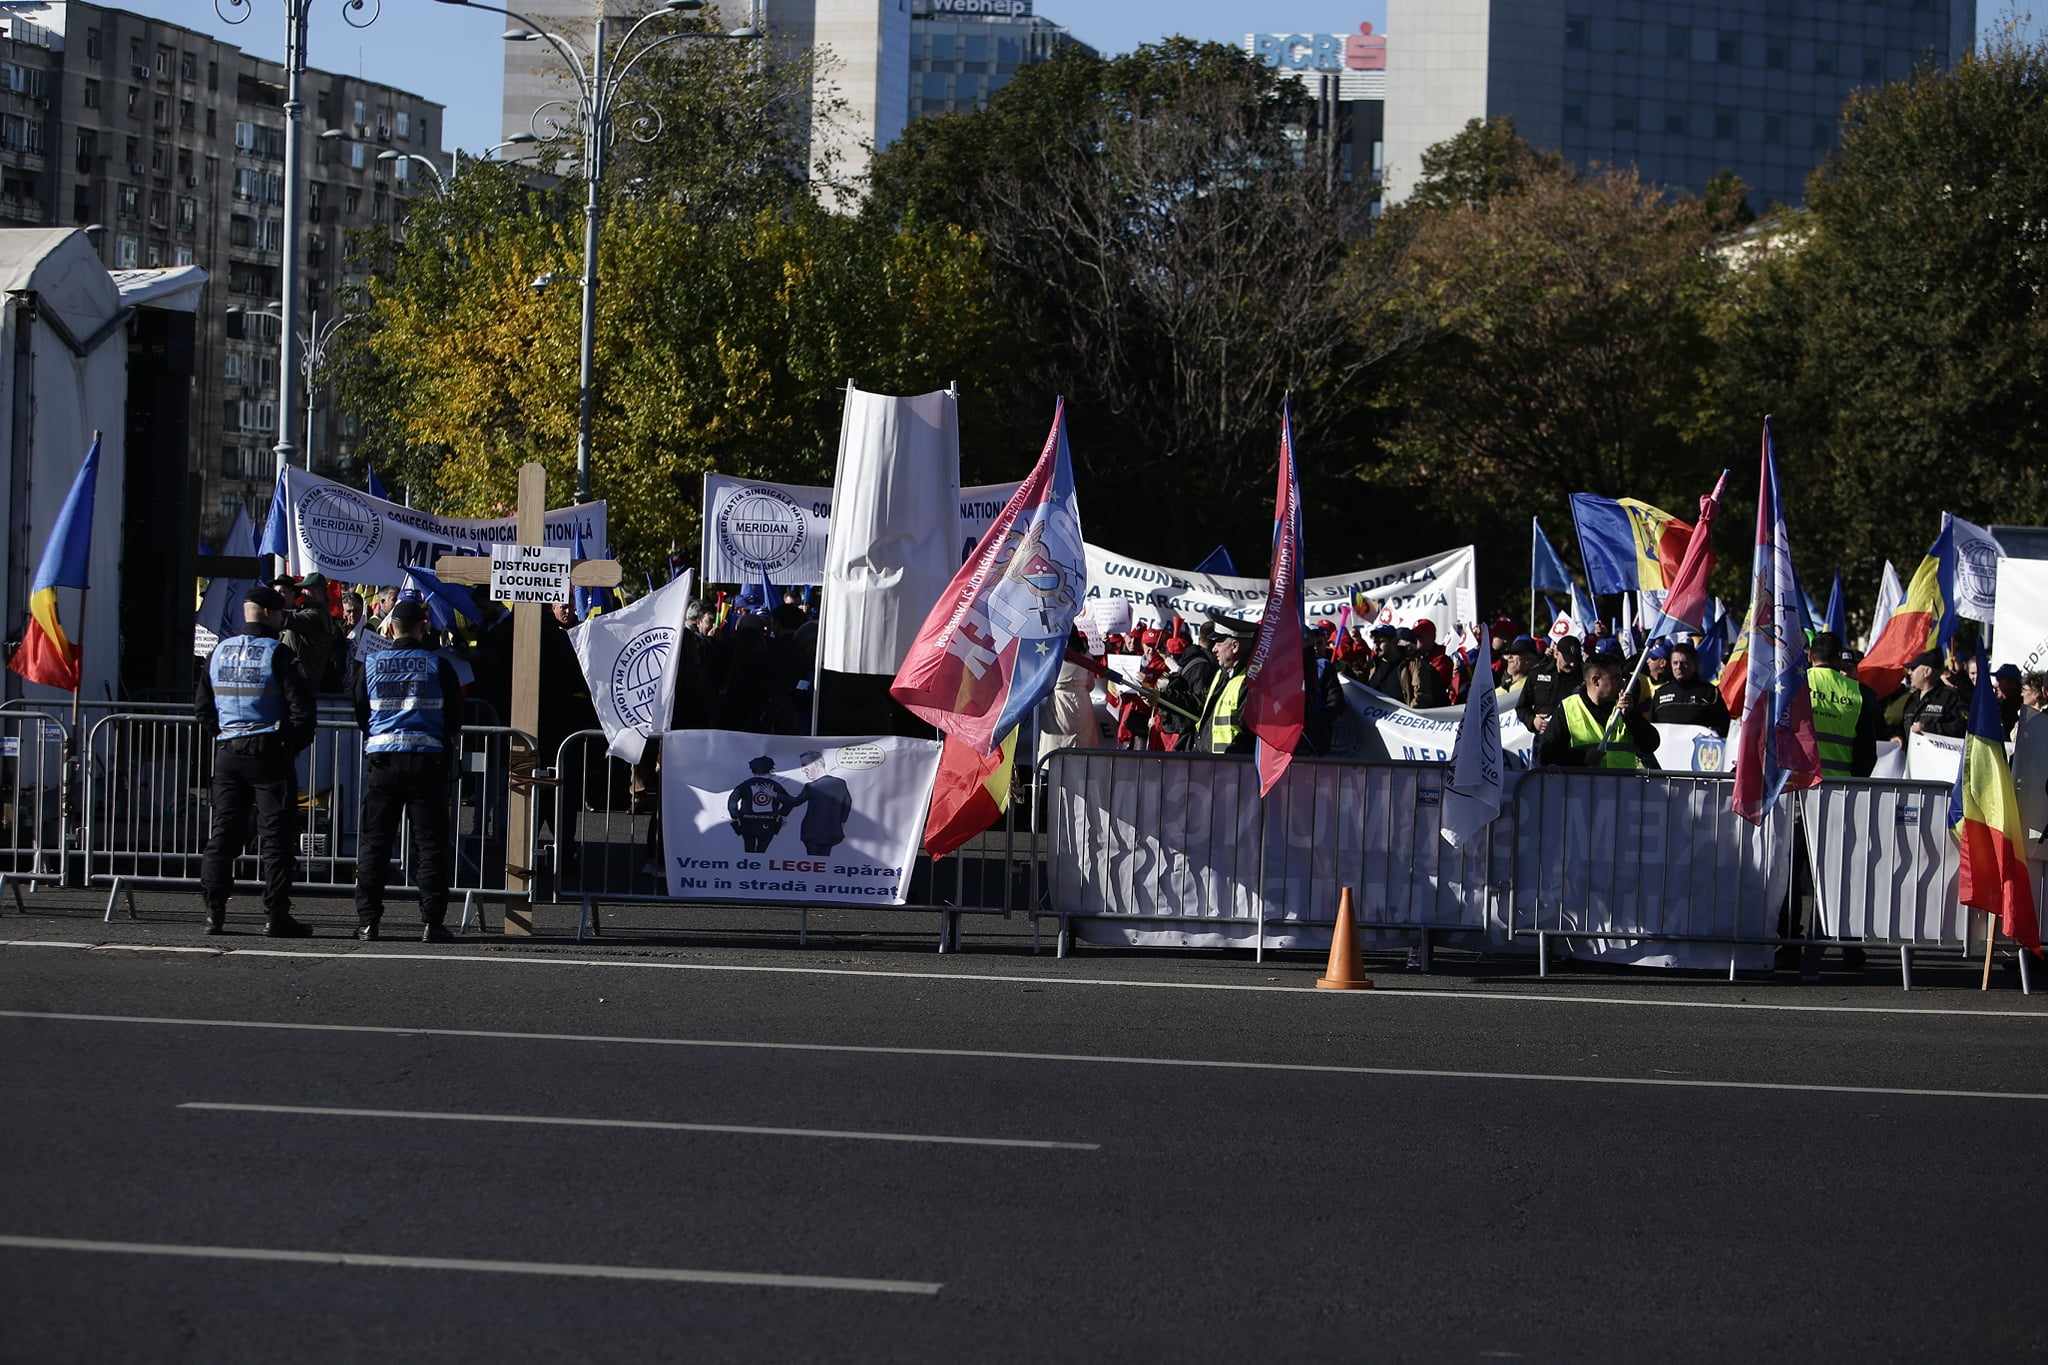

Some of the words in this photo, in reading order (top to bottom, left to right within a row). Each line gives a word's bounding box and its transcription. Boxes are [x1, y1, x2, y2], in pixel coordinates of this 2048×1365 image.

[934, 0, 1026, 18] Webhelp
[1254, 33, 1342, 72] BCR
[960, 502, 1006, 523] NAȚION
[312, 517, 364, 534] MERIDIAN
[470, 525, 517, 542] SINDICA
[735, 522, 789, 534] MERIDIAN
[523, 546, 541, 558] NU
[499, 575, 562, 588] LOCURILE
[1104, 561, 1196, 590] UNIUNEA
[495, 590, 511, 600] DE
[515, 590, 565, 603] MUNCĂ!
[377, 658, 426, 673] DIALOG
[1830, 690, 1854, 706] Lex
[676, 856, 729, 870] Vrem
[736, 858, 761, 871] de
[768, 859, 827, 873] LEGE
[680, 877, 708, 889] Nu
[714, 877, 732, 890] în
[738, 879, 808, 893] stradă
